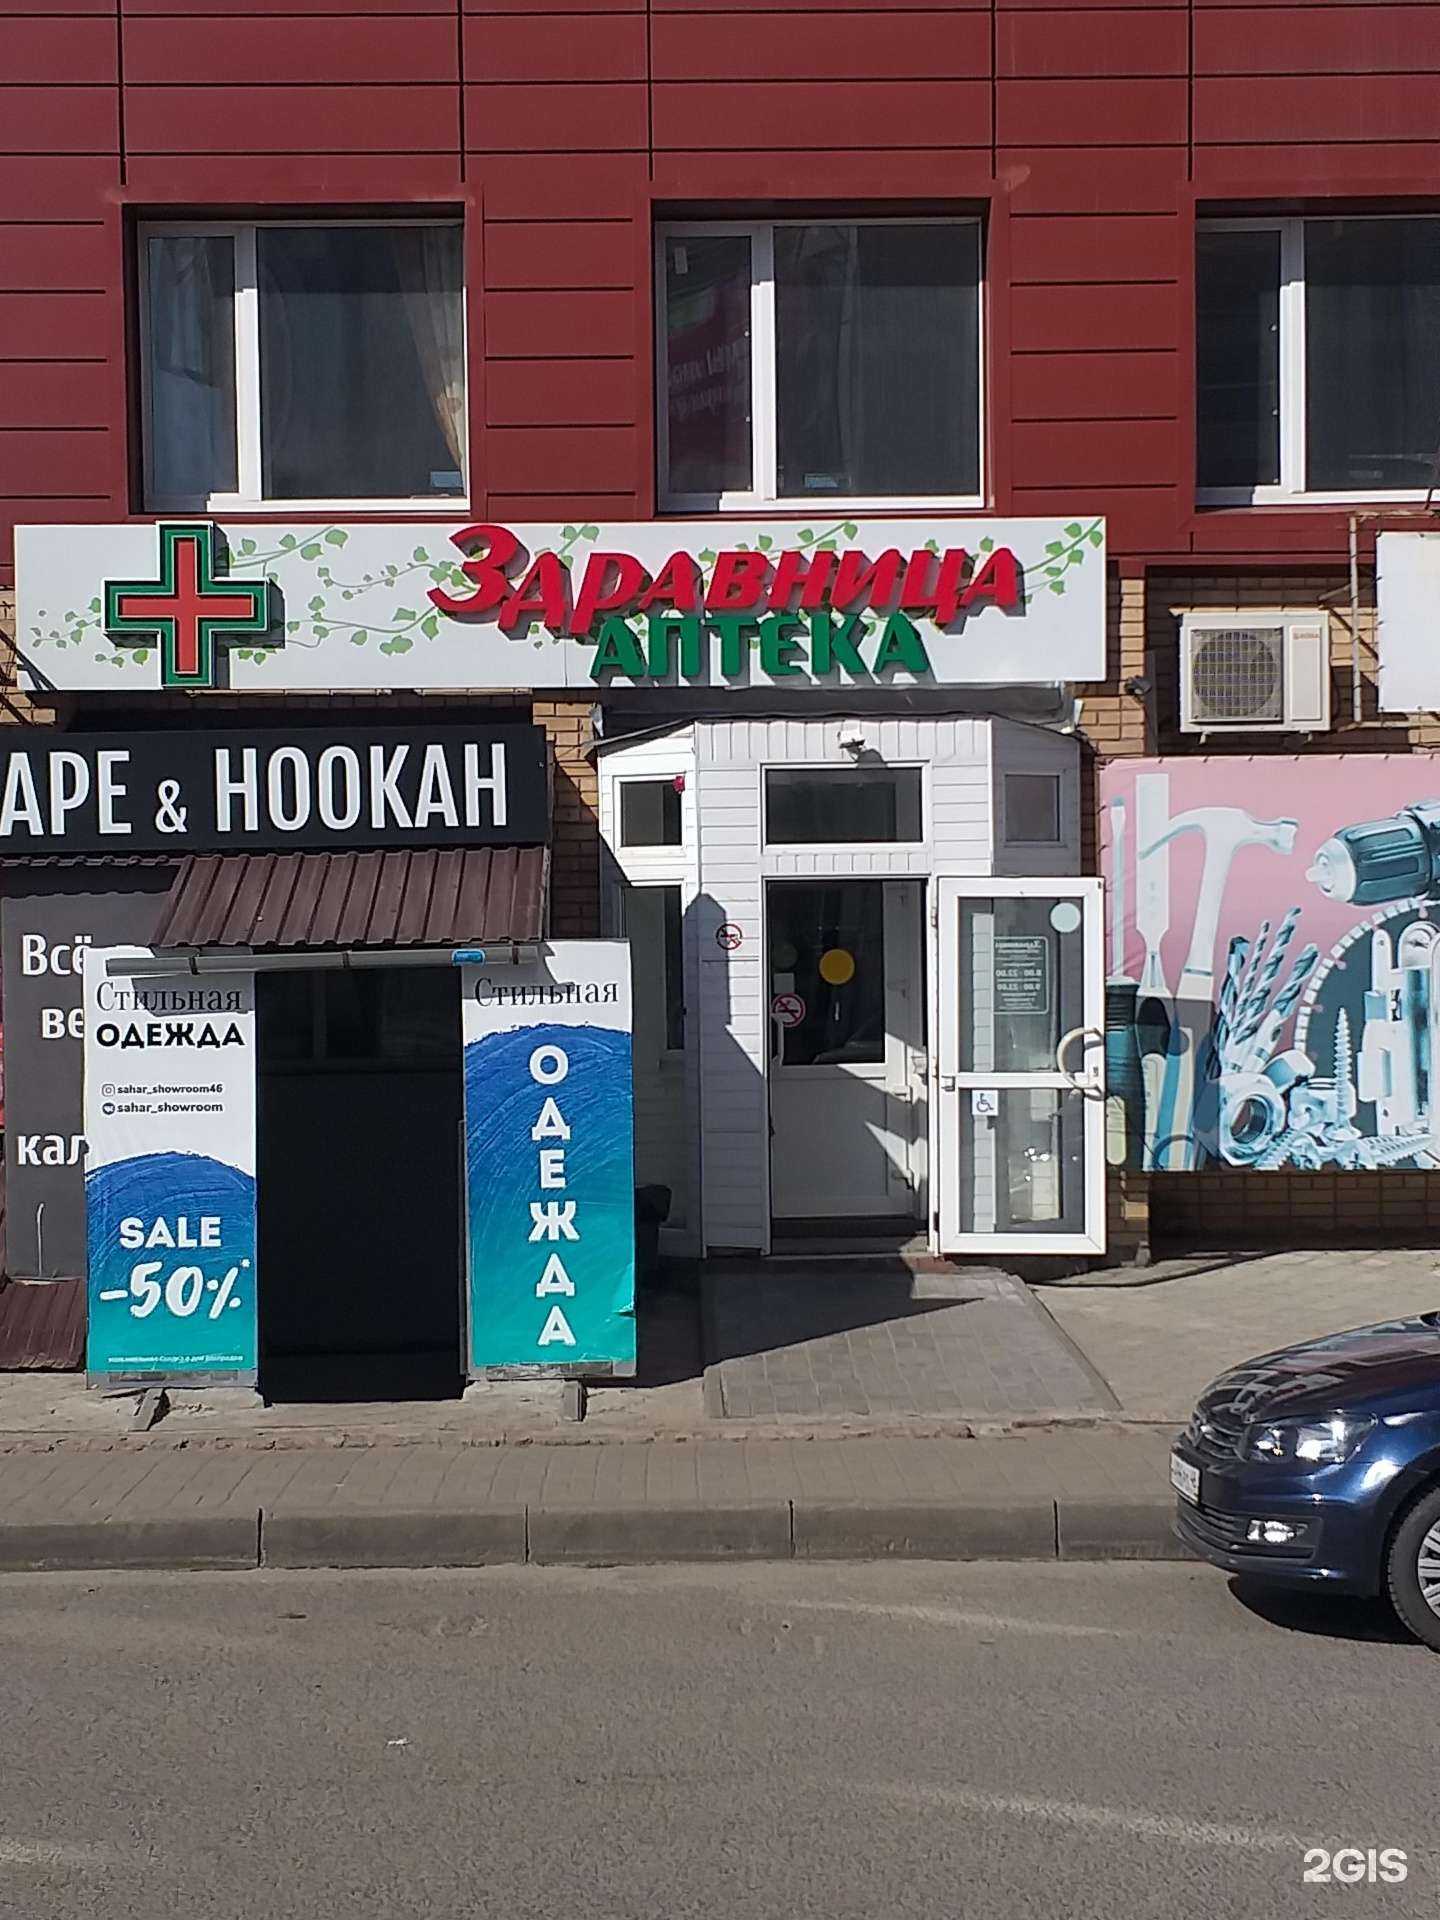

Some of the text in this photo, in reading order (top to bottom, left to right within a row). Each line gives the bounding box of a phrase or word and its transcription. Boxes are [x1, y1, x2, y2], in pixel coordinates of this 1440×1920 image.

[589, 612, 931, 678] АПТЕКА
[0, 743, 508, 836] APE & HOOKAH
[97, 981, 242, 1011] Стильная
[474, 977, 619, 1007] Стильная
[96, 1023, 245, 1049] ОДЕЖДА
[117, 1083, 223, 1095] sahar_showroom46
[117, 1102, 223, 1115] sahar_showroom
[528, 1044, 580, 1346] ОДЕЖДА
[119, 1216, 222, 1249] SALE
